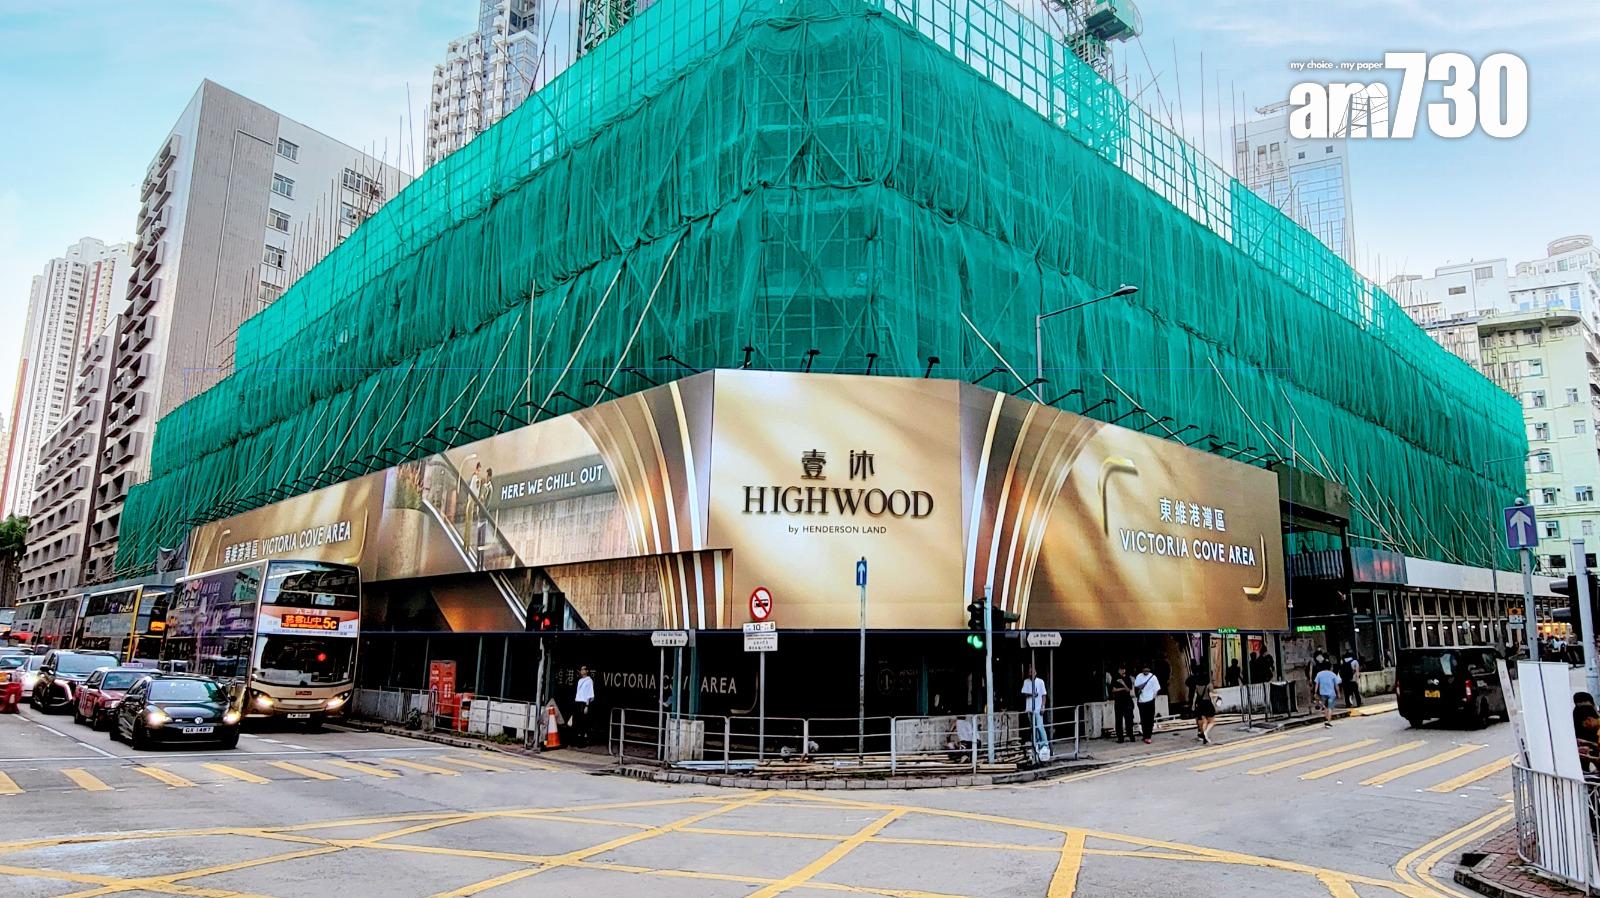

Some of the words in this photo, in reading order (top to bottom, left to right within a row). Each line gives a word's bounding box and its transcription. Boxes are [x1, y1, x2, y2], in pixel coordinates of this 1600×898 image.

[501, 482, 526, 500] HERE
[527, 478, 543, 495] WE
[546, 471, 577, 492] CHILL
[580, 464, 604, 484] OUT
[742, 486, 934, 519] HIGHWOOD
[1159, 497, 1226, 532] 東維港灣區
[262, 533, 297, 556] VICTORIA
[299, 526, 324, 549] COVE
[325, 520, 351, 544] AREA
[788, 525, 799, 535] by
[802, 525, 860, 534] HENDERSON
[862, 526, 887, 535] LAND
[1120, 528, 1190, 558] VICTORIA
[1192, 539, 1226, 563] COVE
[1228, 545, 1256, 566] AREA
[603, 672, 657, 690] VICTORIA
[701, 676, 737, 694] AREA
